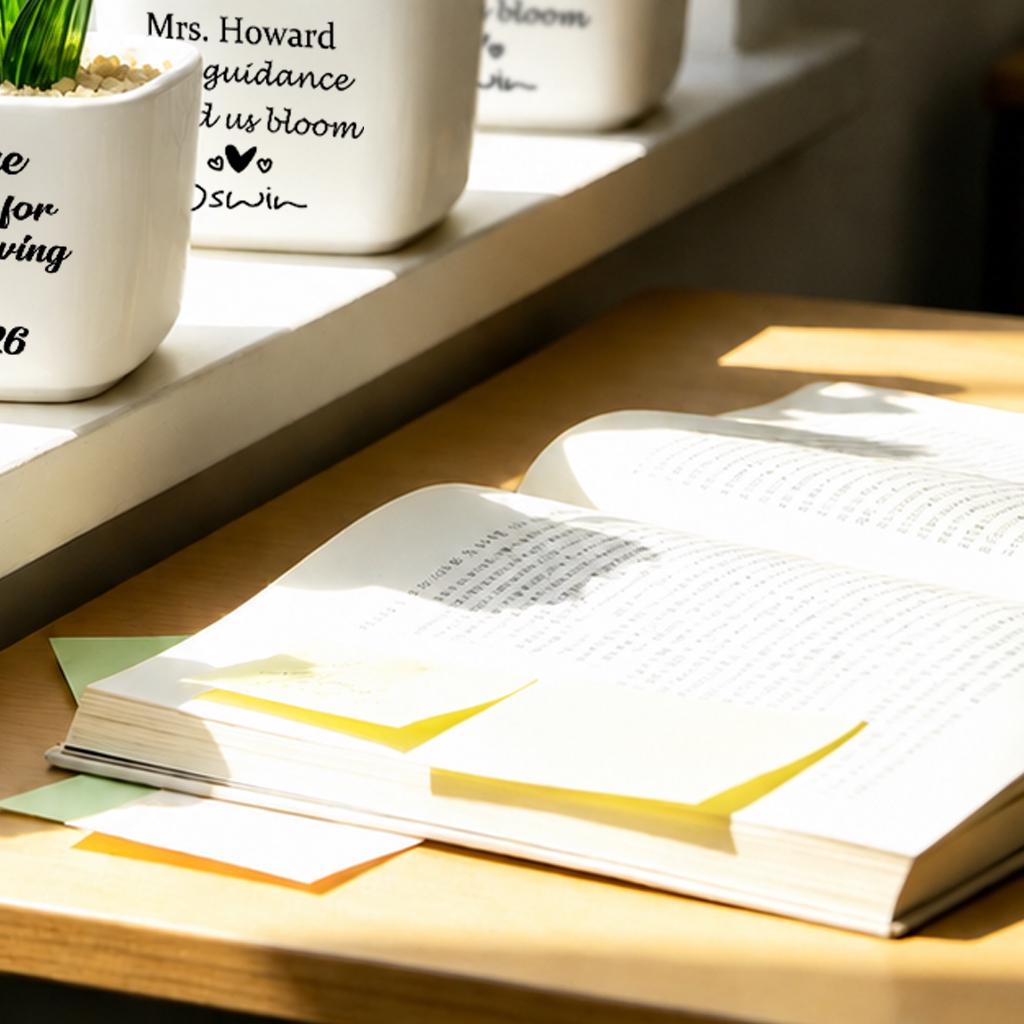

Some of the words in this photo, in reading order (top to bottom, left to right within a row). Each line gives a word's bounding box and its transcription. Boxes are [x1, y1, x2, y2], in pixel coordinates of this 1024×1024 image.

[147, 11, 209, 42] Mrs.
[219, 16, 337, 50] Howard
[202, 60, 356, 92] guidance
[225, 113, 262, 134] us
[266, 106, 365, 140] bloom
